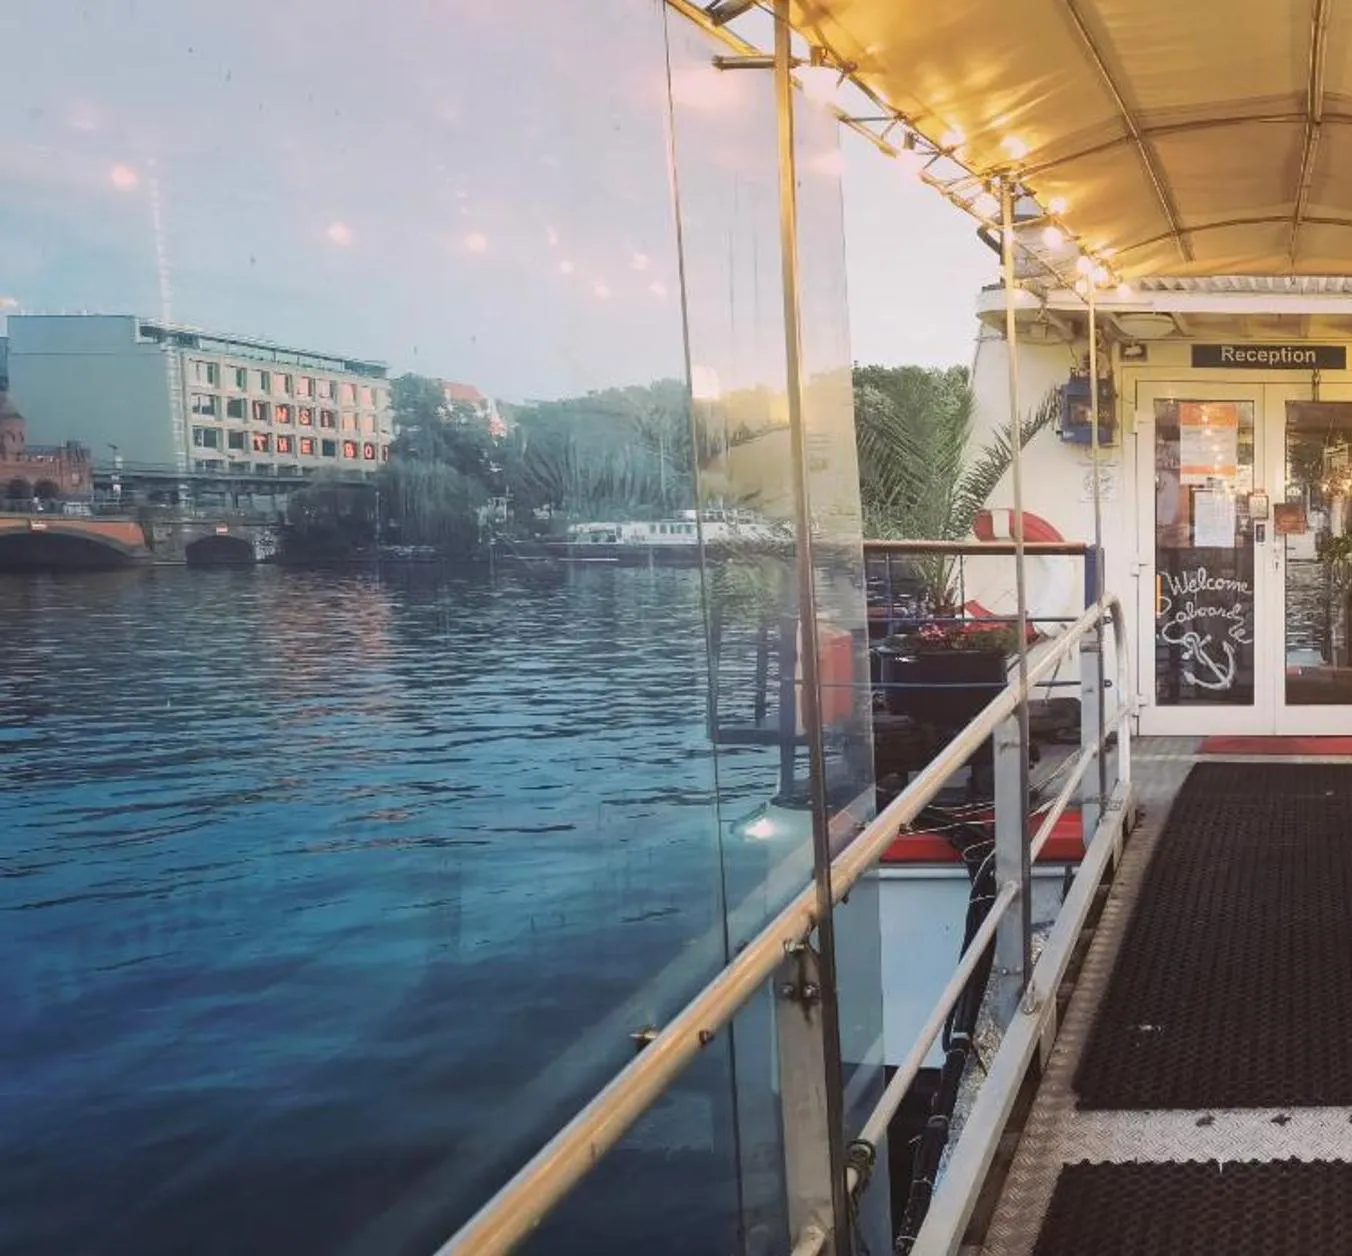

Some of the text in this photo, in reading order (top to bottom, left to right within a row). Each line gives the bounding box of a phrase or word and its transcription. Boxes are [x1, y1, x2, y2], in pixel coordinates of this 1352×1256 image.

[1220, 346, 1317, 365] Reception
[1162, 567, 1252, 596] Welcome
[1175, 601, 1242, 624] aboard
